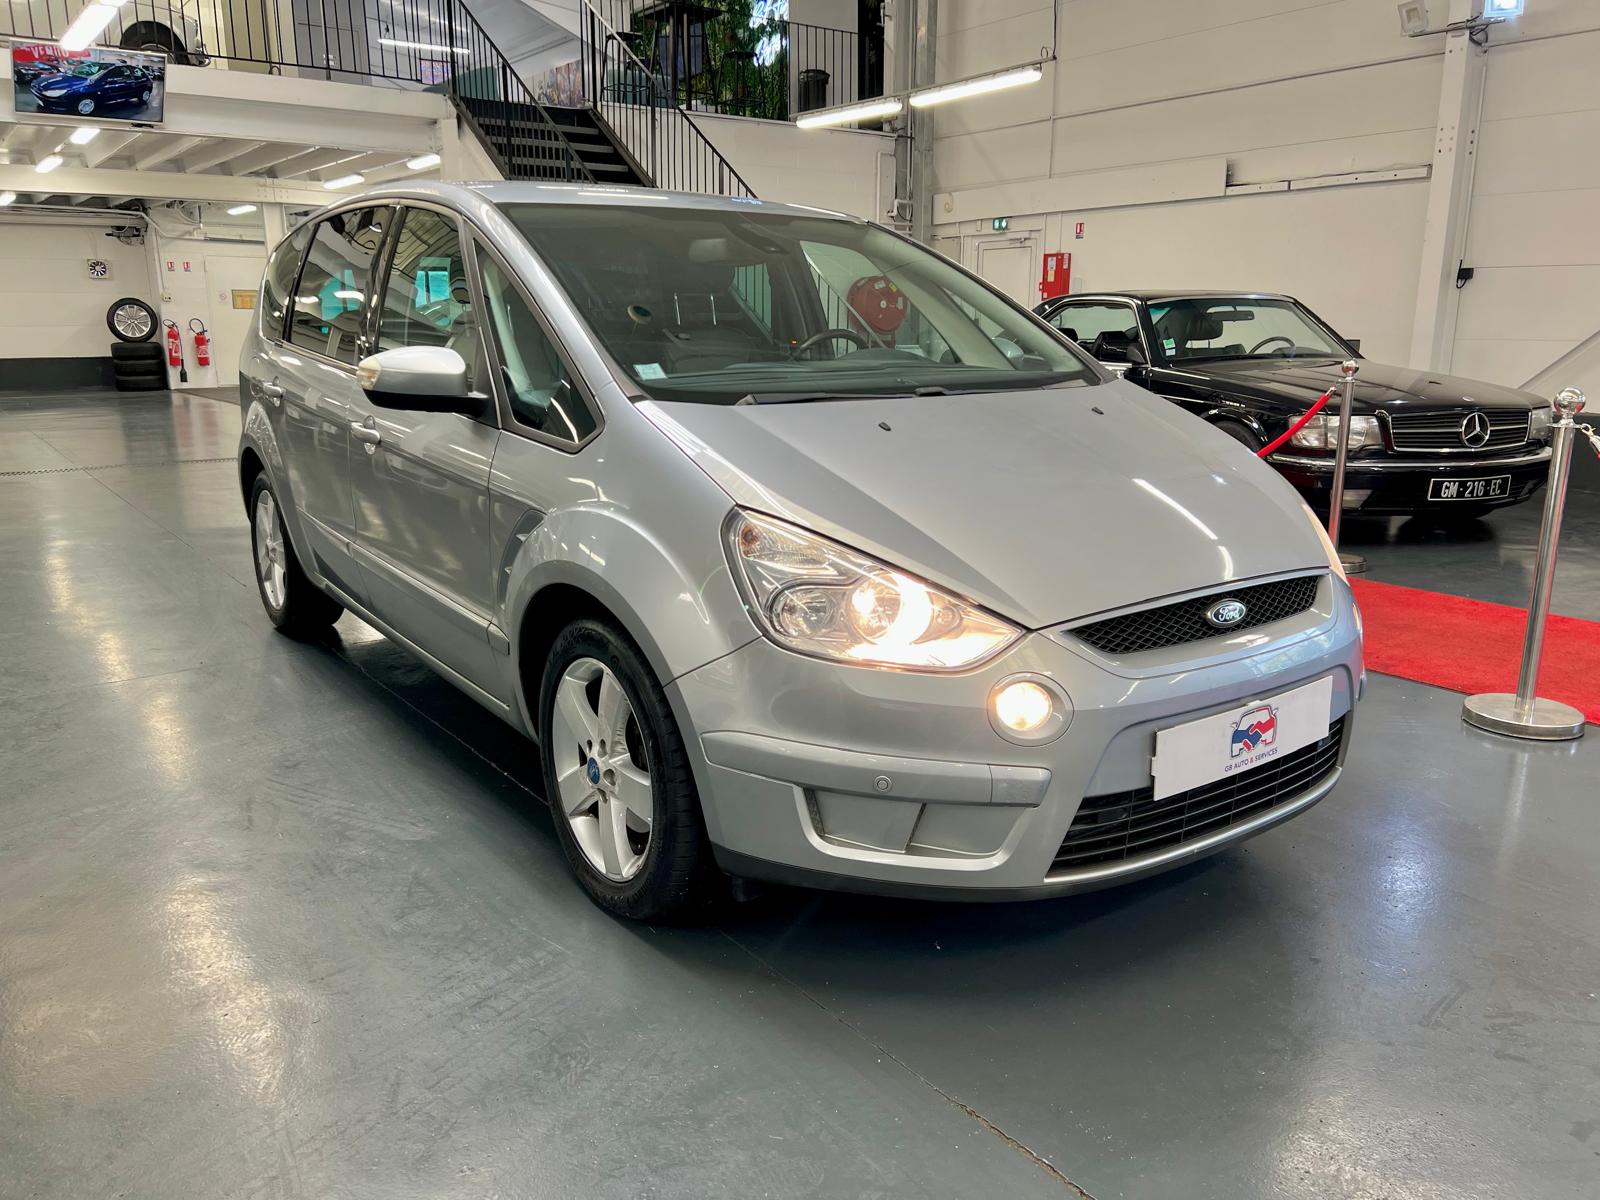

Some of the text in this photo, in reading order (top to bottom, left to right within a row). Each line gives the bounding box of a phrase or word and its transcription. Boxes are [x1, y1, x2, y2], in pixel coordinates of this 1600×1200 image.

[1219, 605, 1240, 621] Ford
[1224, 764, 1233, 772] GB
[1234, 758, 1249, 769] AUTO
[1254, 746, 1278, 761] SERVICES
